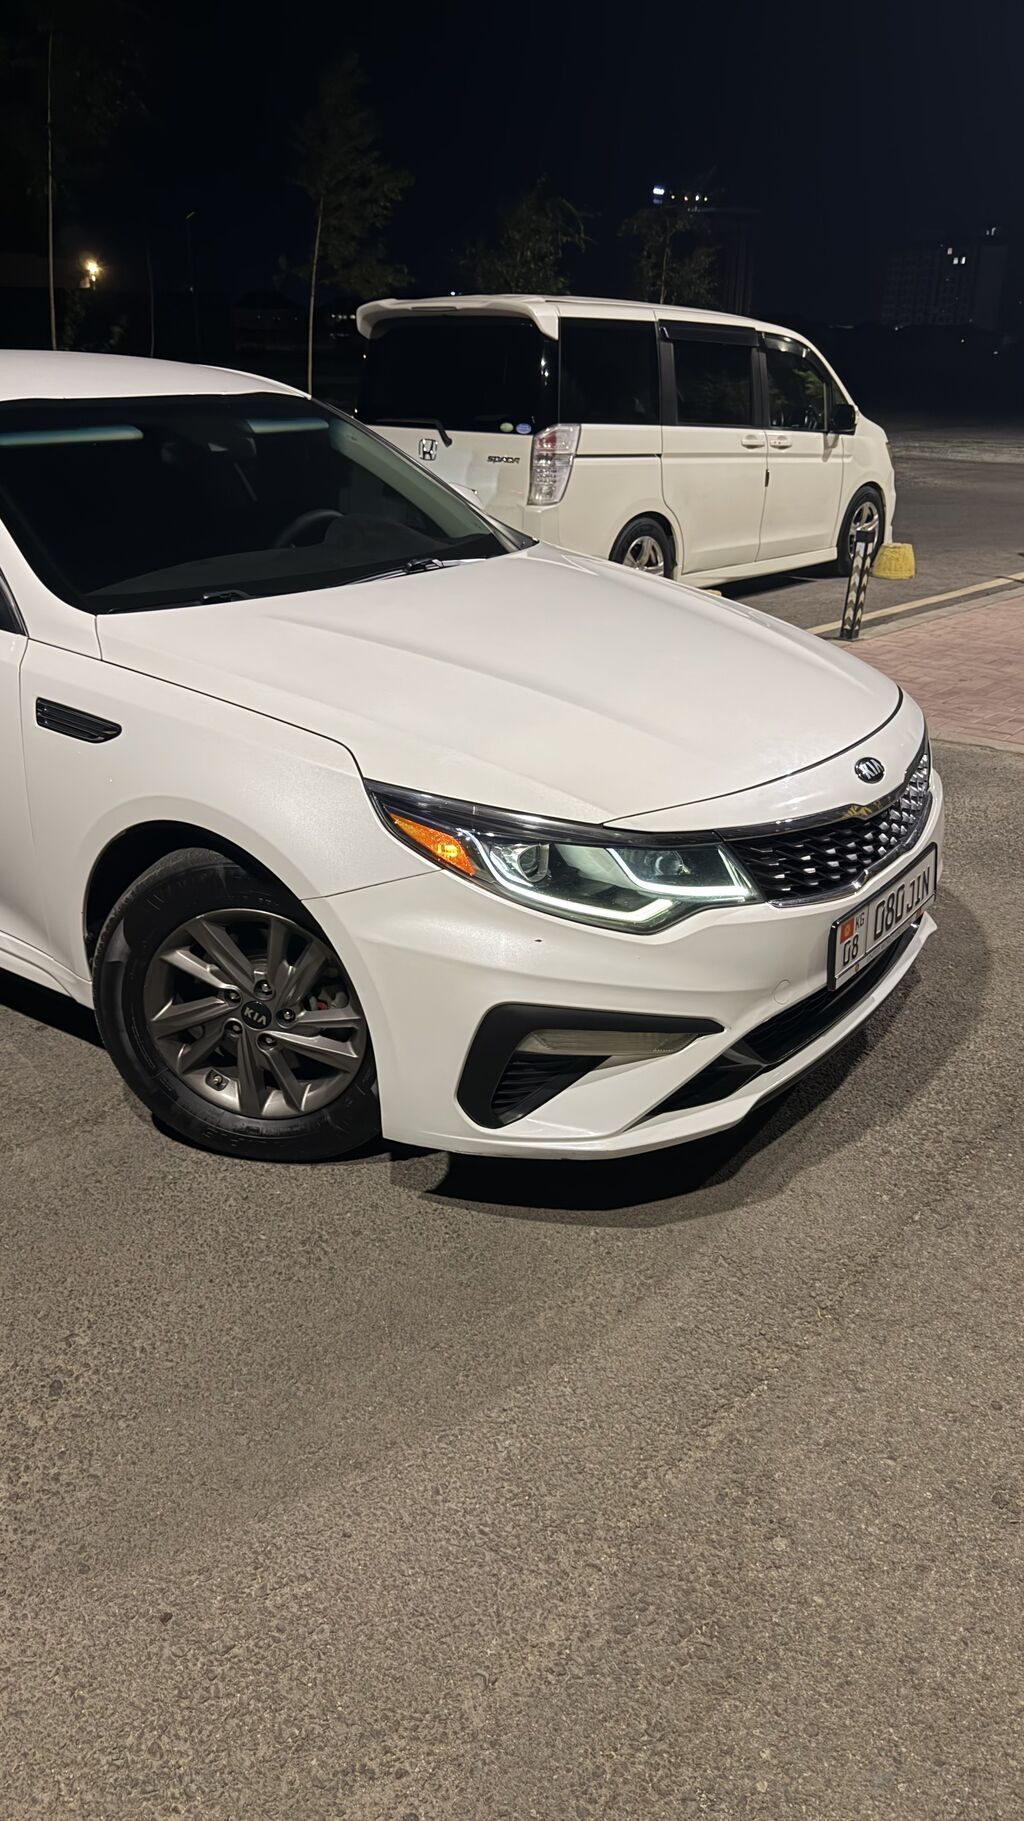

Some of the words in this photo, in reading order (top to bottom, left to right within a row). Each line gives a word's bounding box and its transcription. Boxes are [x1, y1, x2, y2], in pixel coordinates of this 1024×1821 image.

[858, 759, 883, 780] KIA
[855, 912, 865, 929] KG
[243, 1006, 266, 1026] KIA
